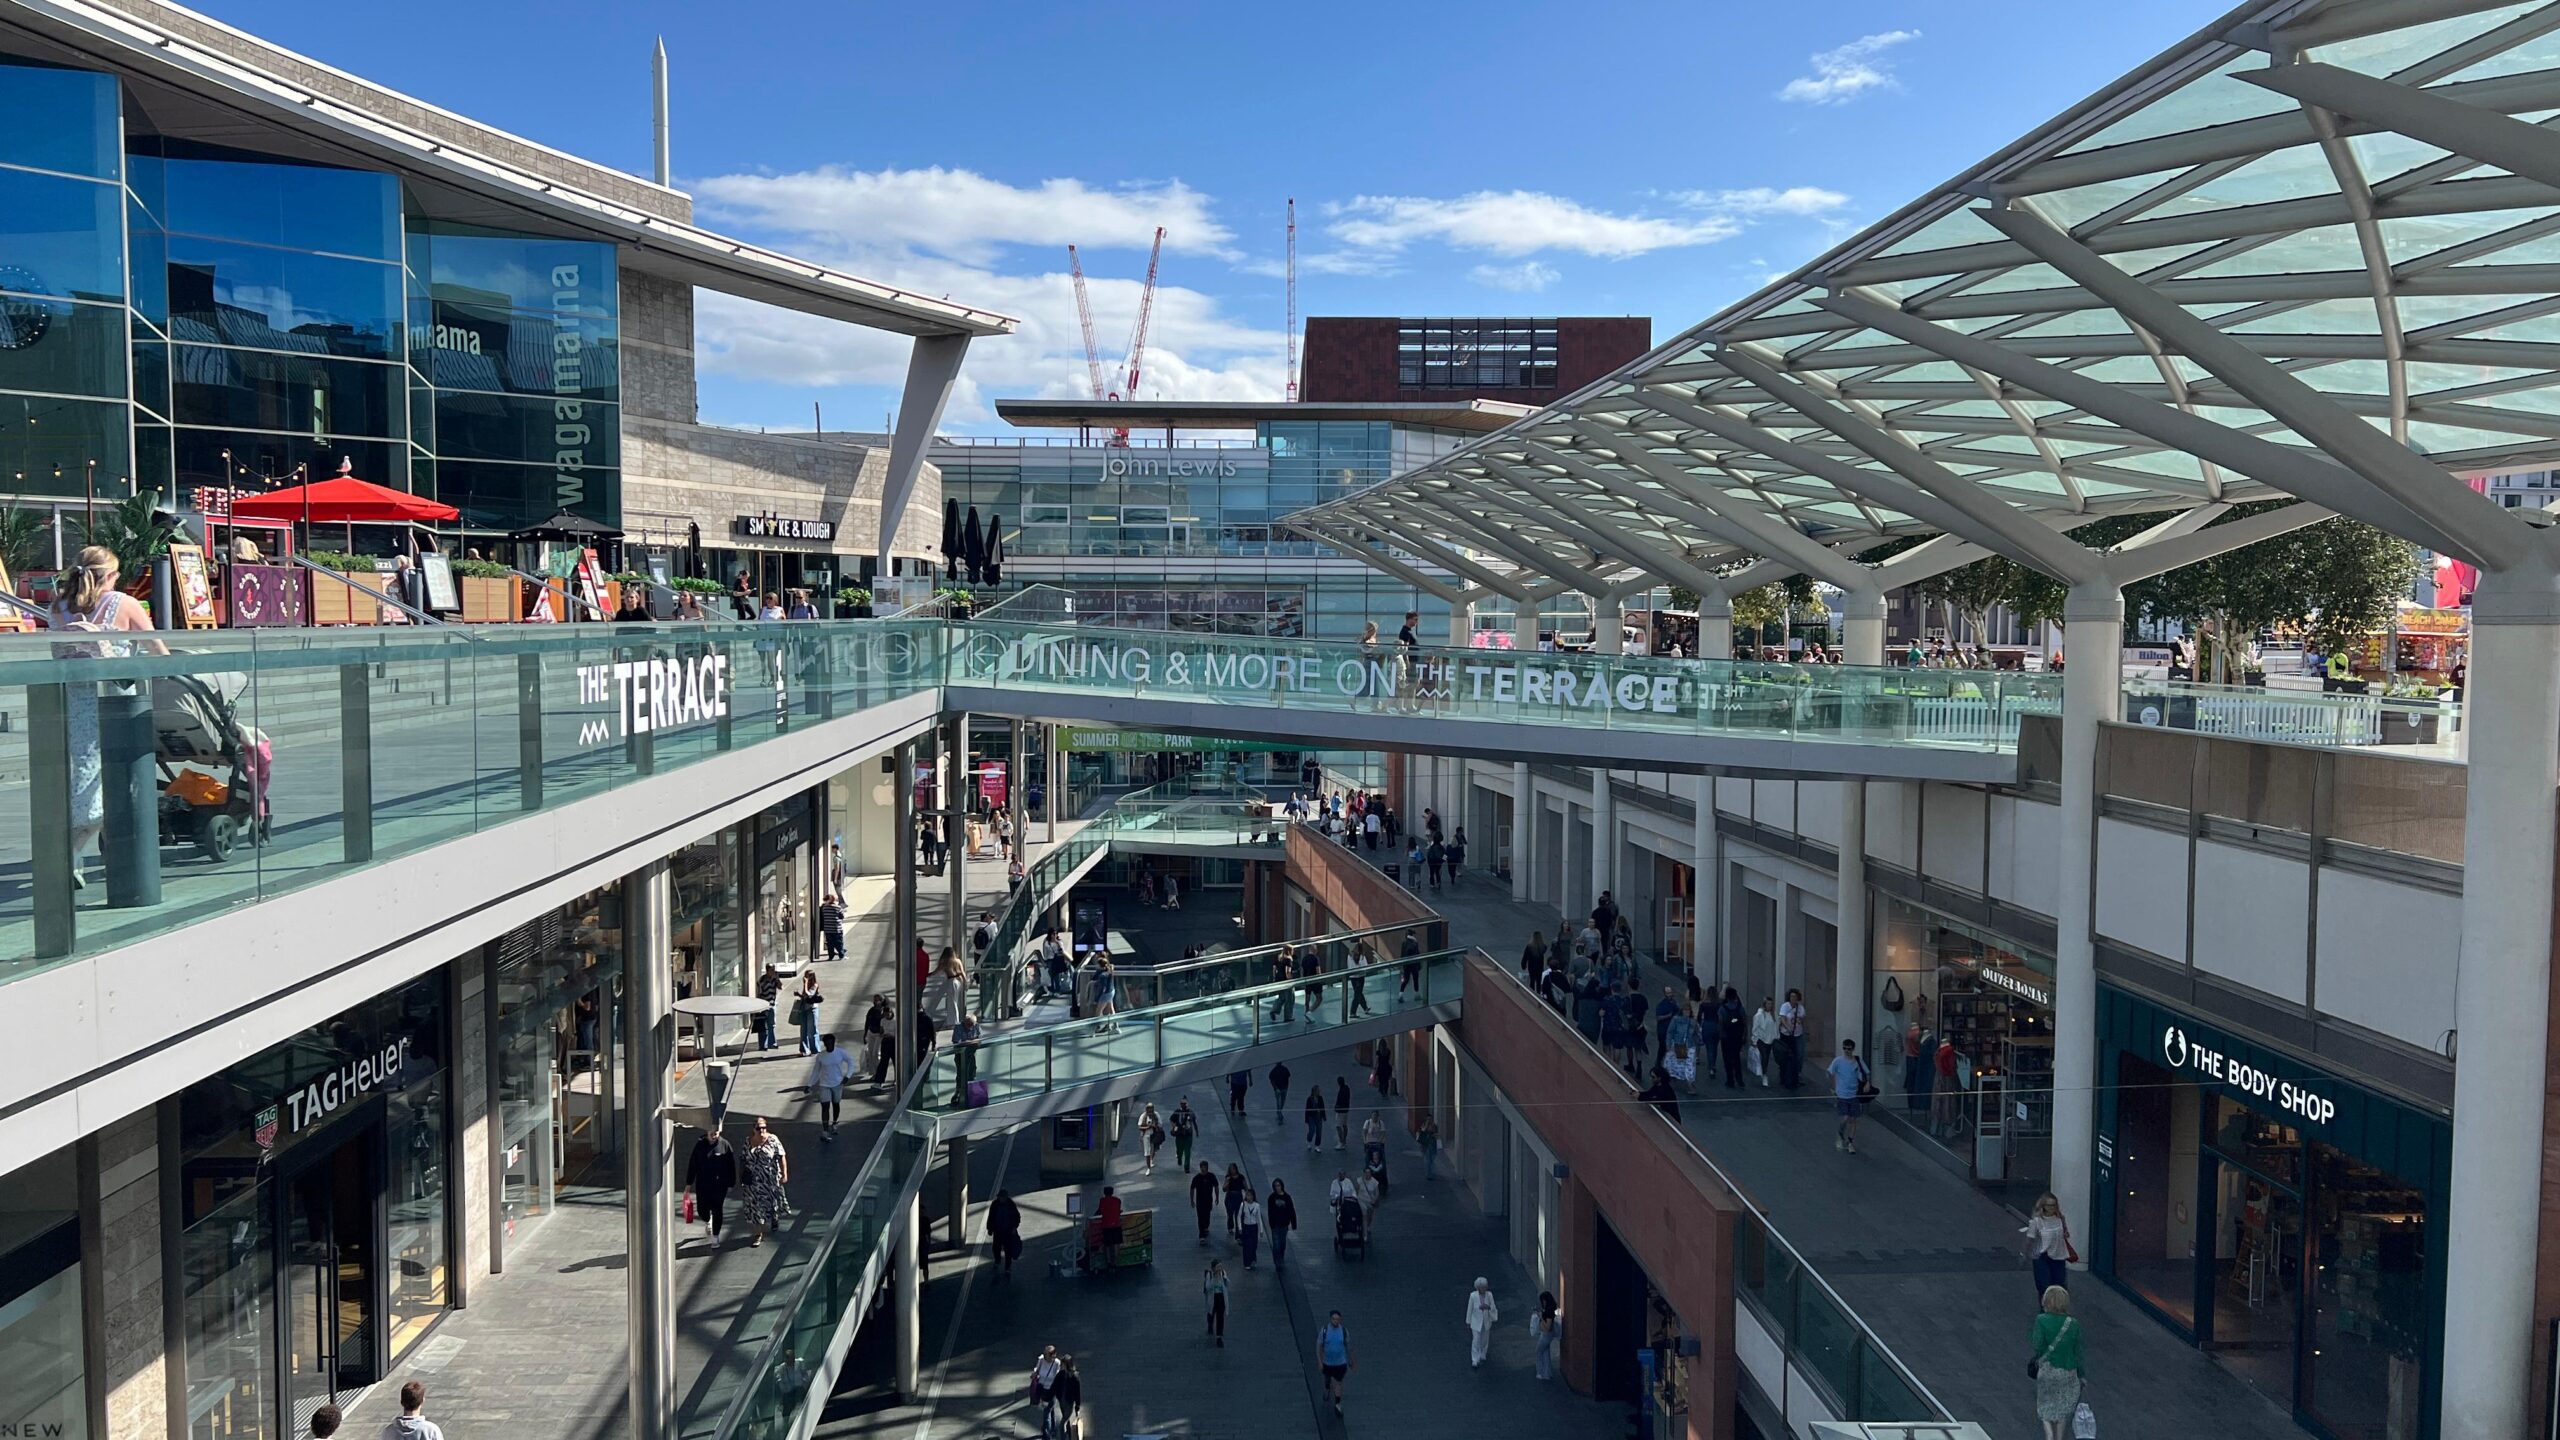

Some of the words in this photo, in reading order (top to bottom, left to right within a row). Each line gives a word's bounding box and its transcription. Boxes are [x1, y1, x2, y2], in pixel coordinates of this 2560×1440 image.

[552, 264, 591, 508] wagamama
[1099, 449, 1159, 482] John
[1167, 450, 1237, 477] Lewis
[749, 517, 791, 537] SMKE
[791, 522, 801, 538] &
[802, 522, 830, 539] DOUGH
[2139, 650, 2169, 660] Hilton
[1010, 639, 1151, 683] DINING
[1165, 651, 1192, 686] &
[1205, 653, 1322, 693] MORE
[1336, 659, 1397, 697] ON
[1416, 663, 1457, 682] THE
[1466, 666, 1678, 713] TERRACE
[577, 664, 609, 705] THE
[614, 654, 727, 737] TERRACE
[1072, 732, 1120, 747] SUMMER
[1121, 732, 1138, 747] ON
[1140, 733, 1162, 748] THE
[1165, 734, 1192, 748] PARK
[1982, 967, 2014, 990] OLIVER
[287, 1072, 339, 1133] TAG
[342, 1036, 408, 1103] Heuer
[2191, 1042, 2224, 1080] THE
[2228, 1058, 2278, 1101] BODY
[2280, 1082, 2335, 1125] SHOP
[256, 1108, 277, 1126] TAG
[256, 1124, 277, 1147] HEUER
[2, 1423, 63, 1437] NEW
